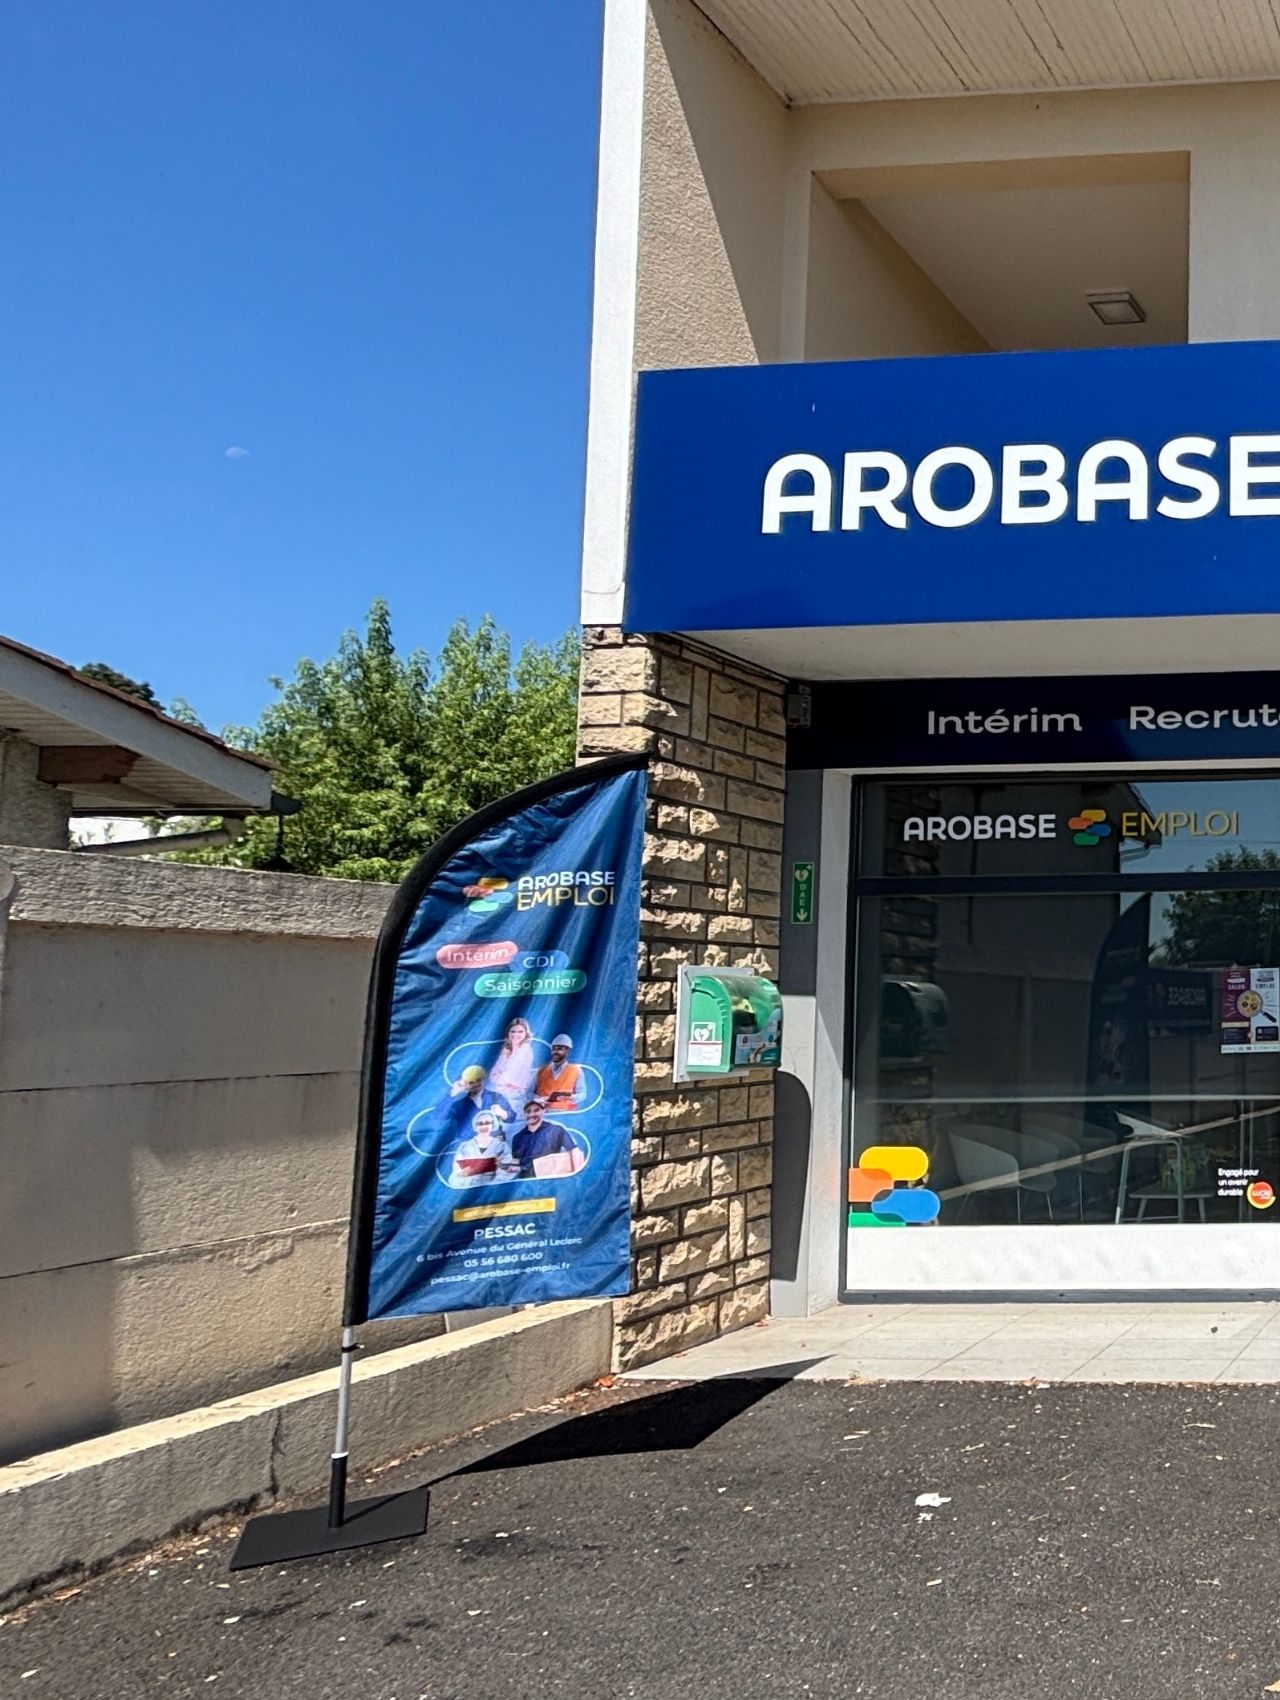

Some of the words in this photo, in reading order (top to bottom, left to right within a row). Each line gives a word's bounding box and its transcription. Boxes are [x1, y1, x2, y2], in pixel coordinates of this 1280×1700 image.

[928, 710, 1082, 734] Intérim
[903, 813, 1056, 842] AROBASE
[1121, 809, 1240, 838] EMPLOI
[517, 871, 615, 891] AROBASE
[517, 886, 615, 911] EMPLOI
[523, 955, 556, 969] CDI
[485, 976, 577, 992] Saisonnier
[474, 1223, 536, 1240] PESSAC
[446, 1246, 487, 1258] Avenue
[489, 1244, 505, 1252] du
[463, 1259, 478, 1268] 05
[480, 1257, 495, 1266] 56
